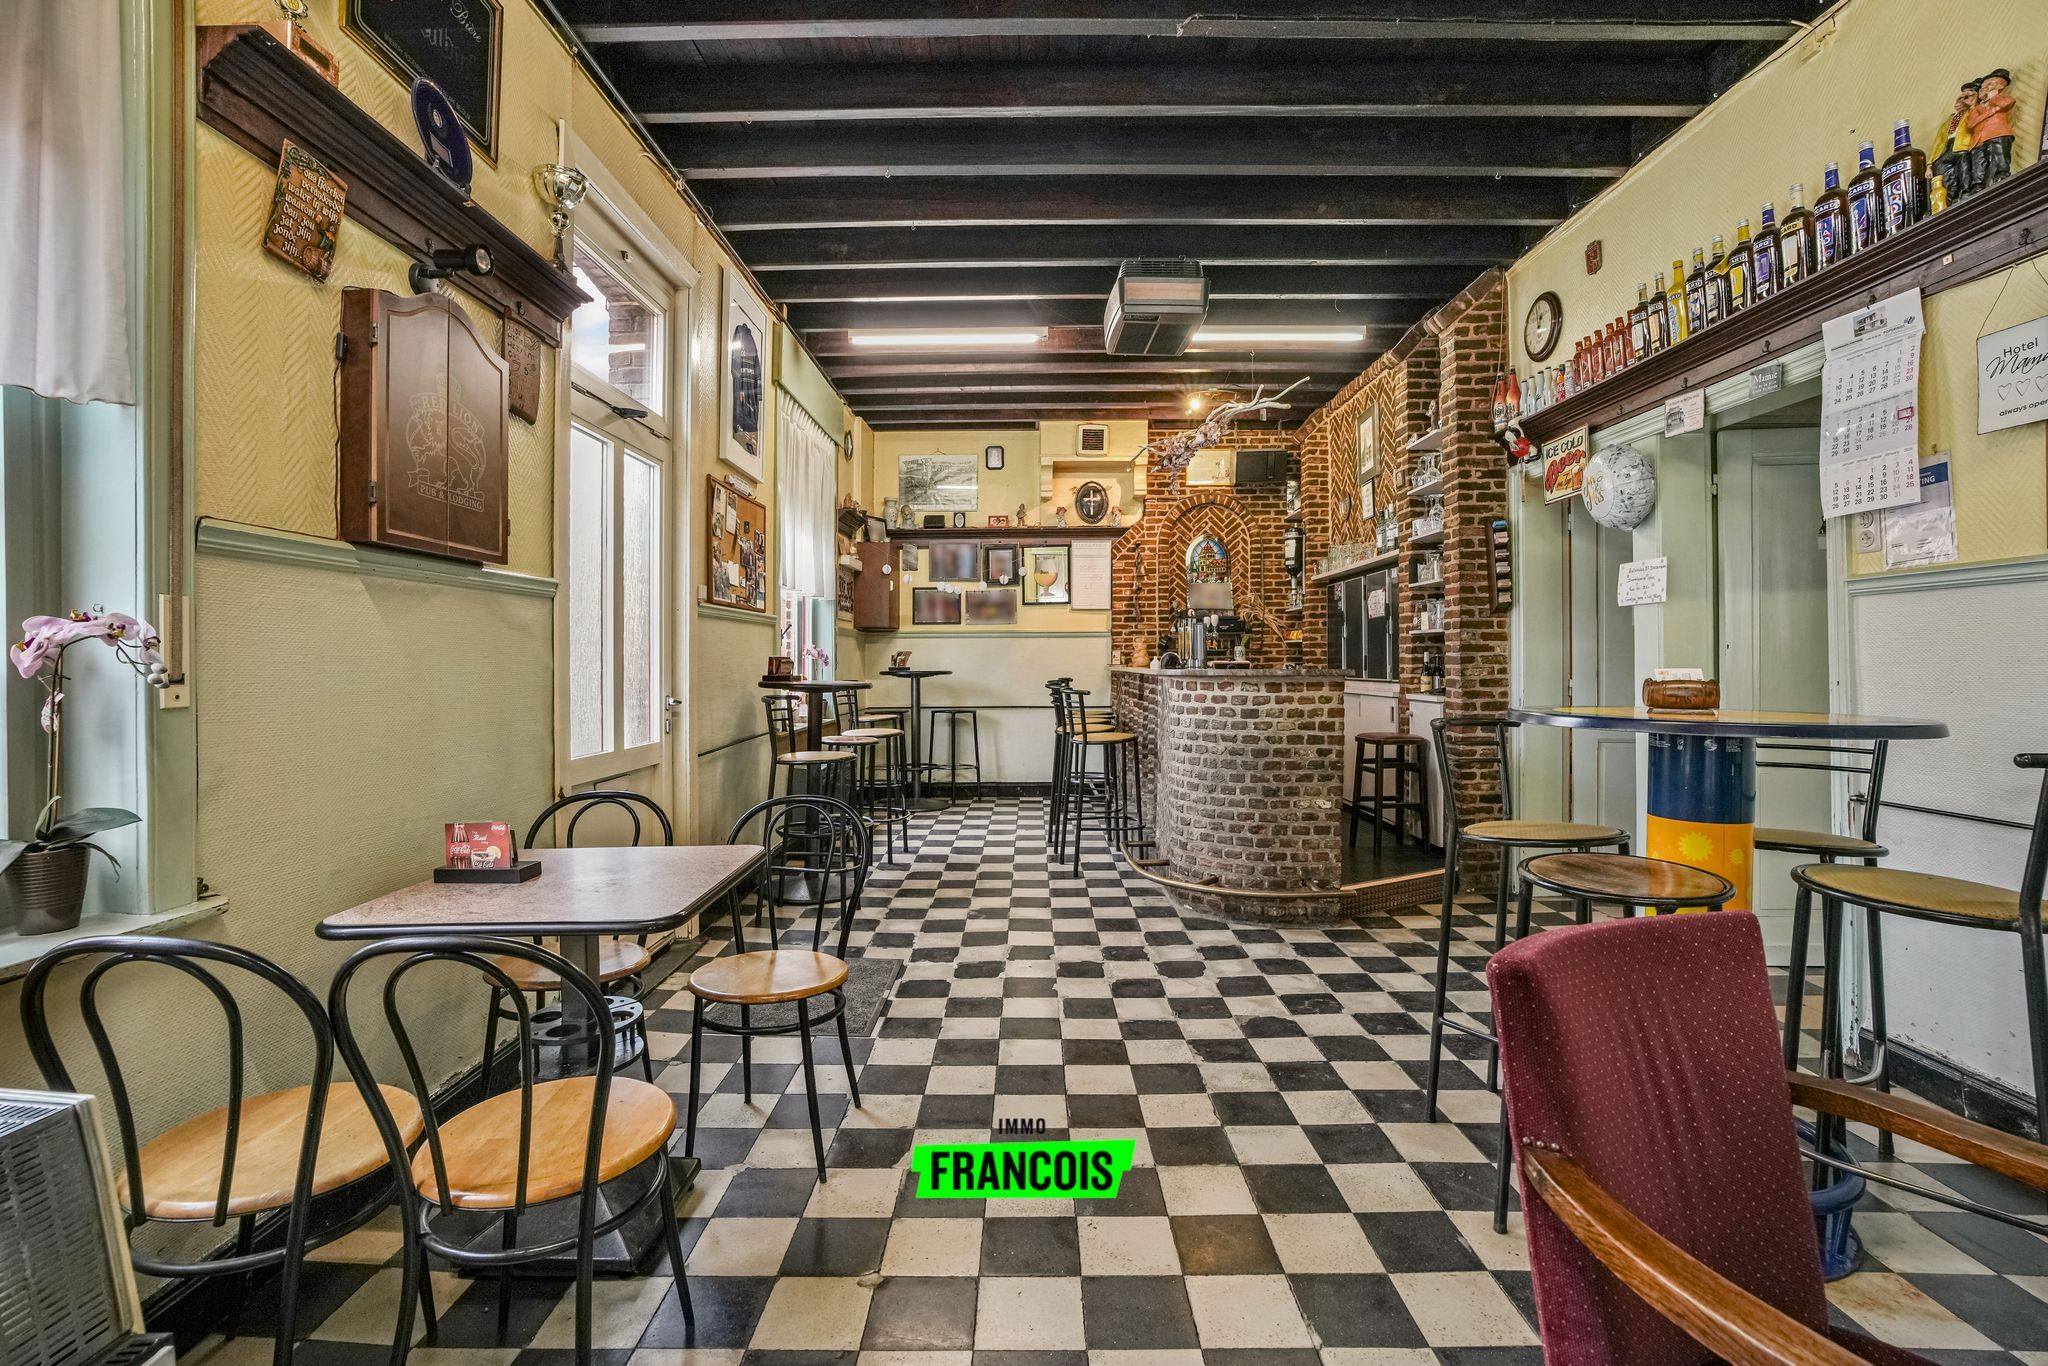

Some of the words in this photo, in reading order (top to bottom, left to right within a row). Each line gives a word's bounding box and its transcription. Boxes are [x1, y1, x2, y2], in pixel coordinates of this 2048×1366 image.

[285, 193, 315, 219] waarom
[288, 182, 311, 201] water
[313, 197, 320, 212] in
[302, 180, 342, 213] veranderde
[296, 226, 312, 242] zijn
[2003, 337, 2038, 358] Hotel
[422, 396, 447, 410] RED
[452, 405, 480, 432] LION
[1999, 404, 2028, 416] always
[1546, 444, 1560, 460] ICE
[1560, 436, 1584, 453] COLD
[1545, 448, 1586, 494] Beer
[1920, 476, 1936, 486] ING
[420, 484, 437, 497] PUB
[439, 490, 445, 499] &
[448, 492, 482, 510] LODGING
